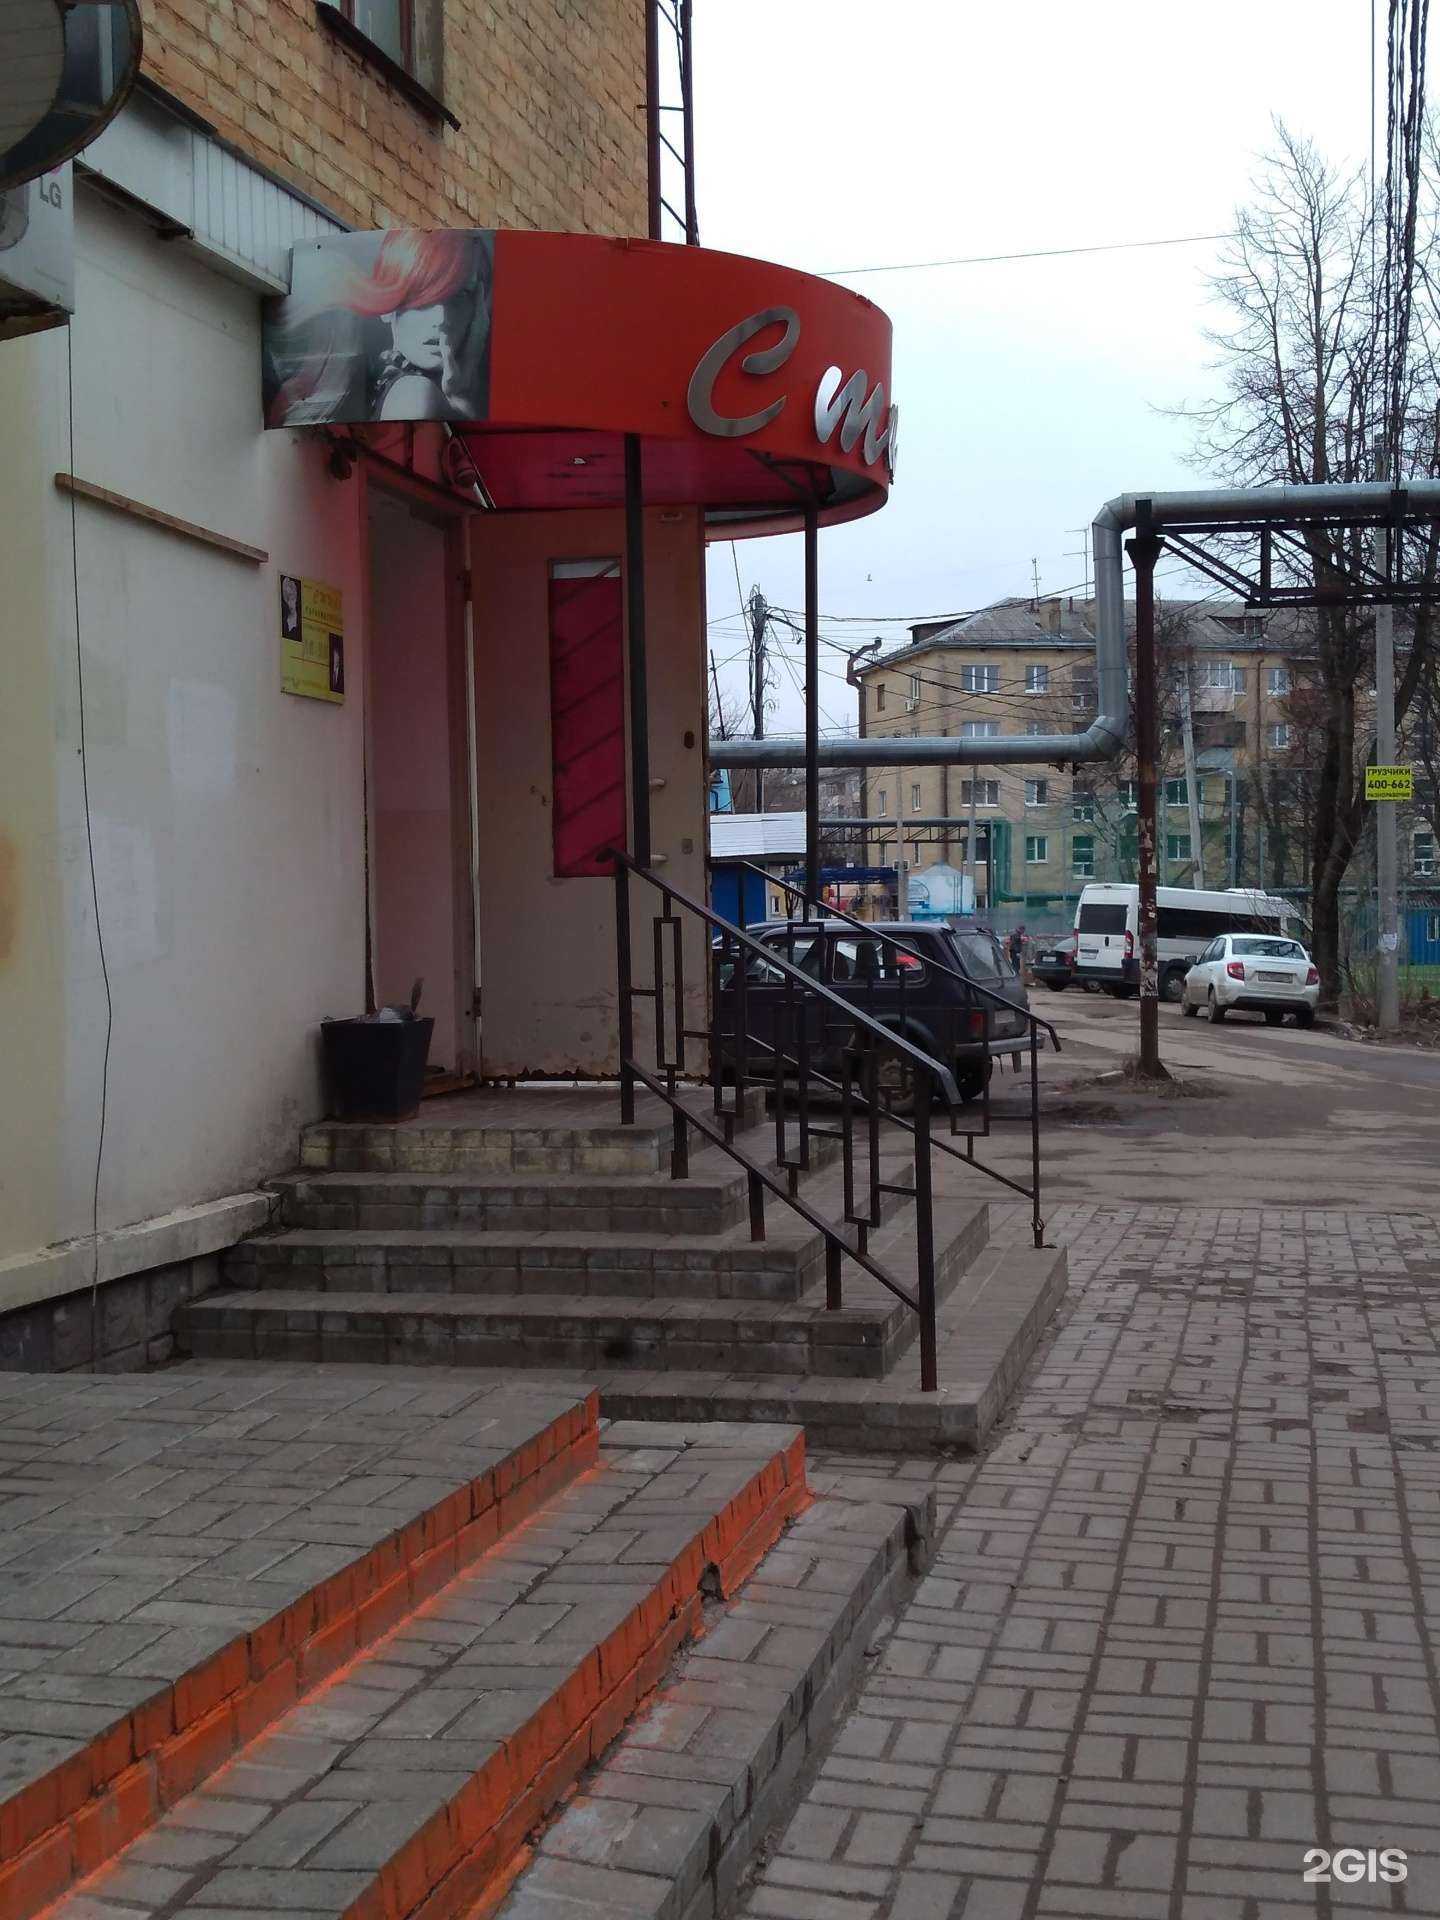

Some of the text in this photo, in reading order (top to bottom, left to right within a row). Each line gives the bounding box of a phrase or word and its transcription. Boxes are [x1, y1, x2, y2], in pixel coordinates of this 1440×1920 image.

[39, 174, 62, 210] LG
[1367, 768, 1411, 776] ГРУЗЧИКИ
[1368, 780, 1411, 789] 400-662
